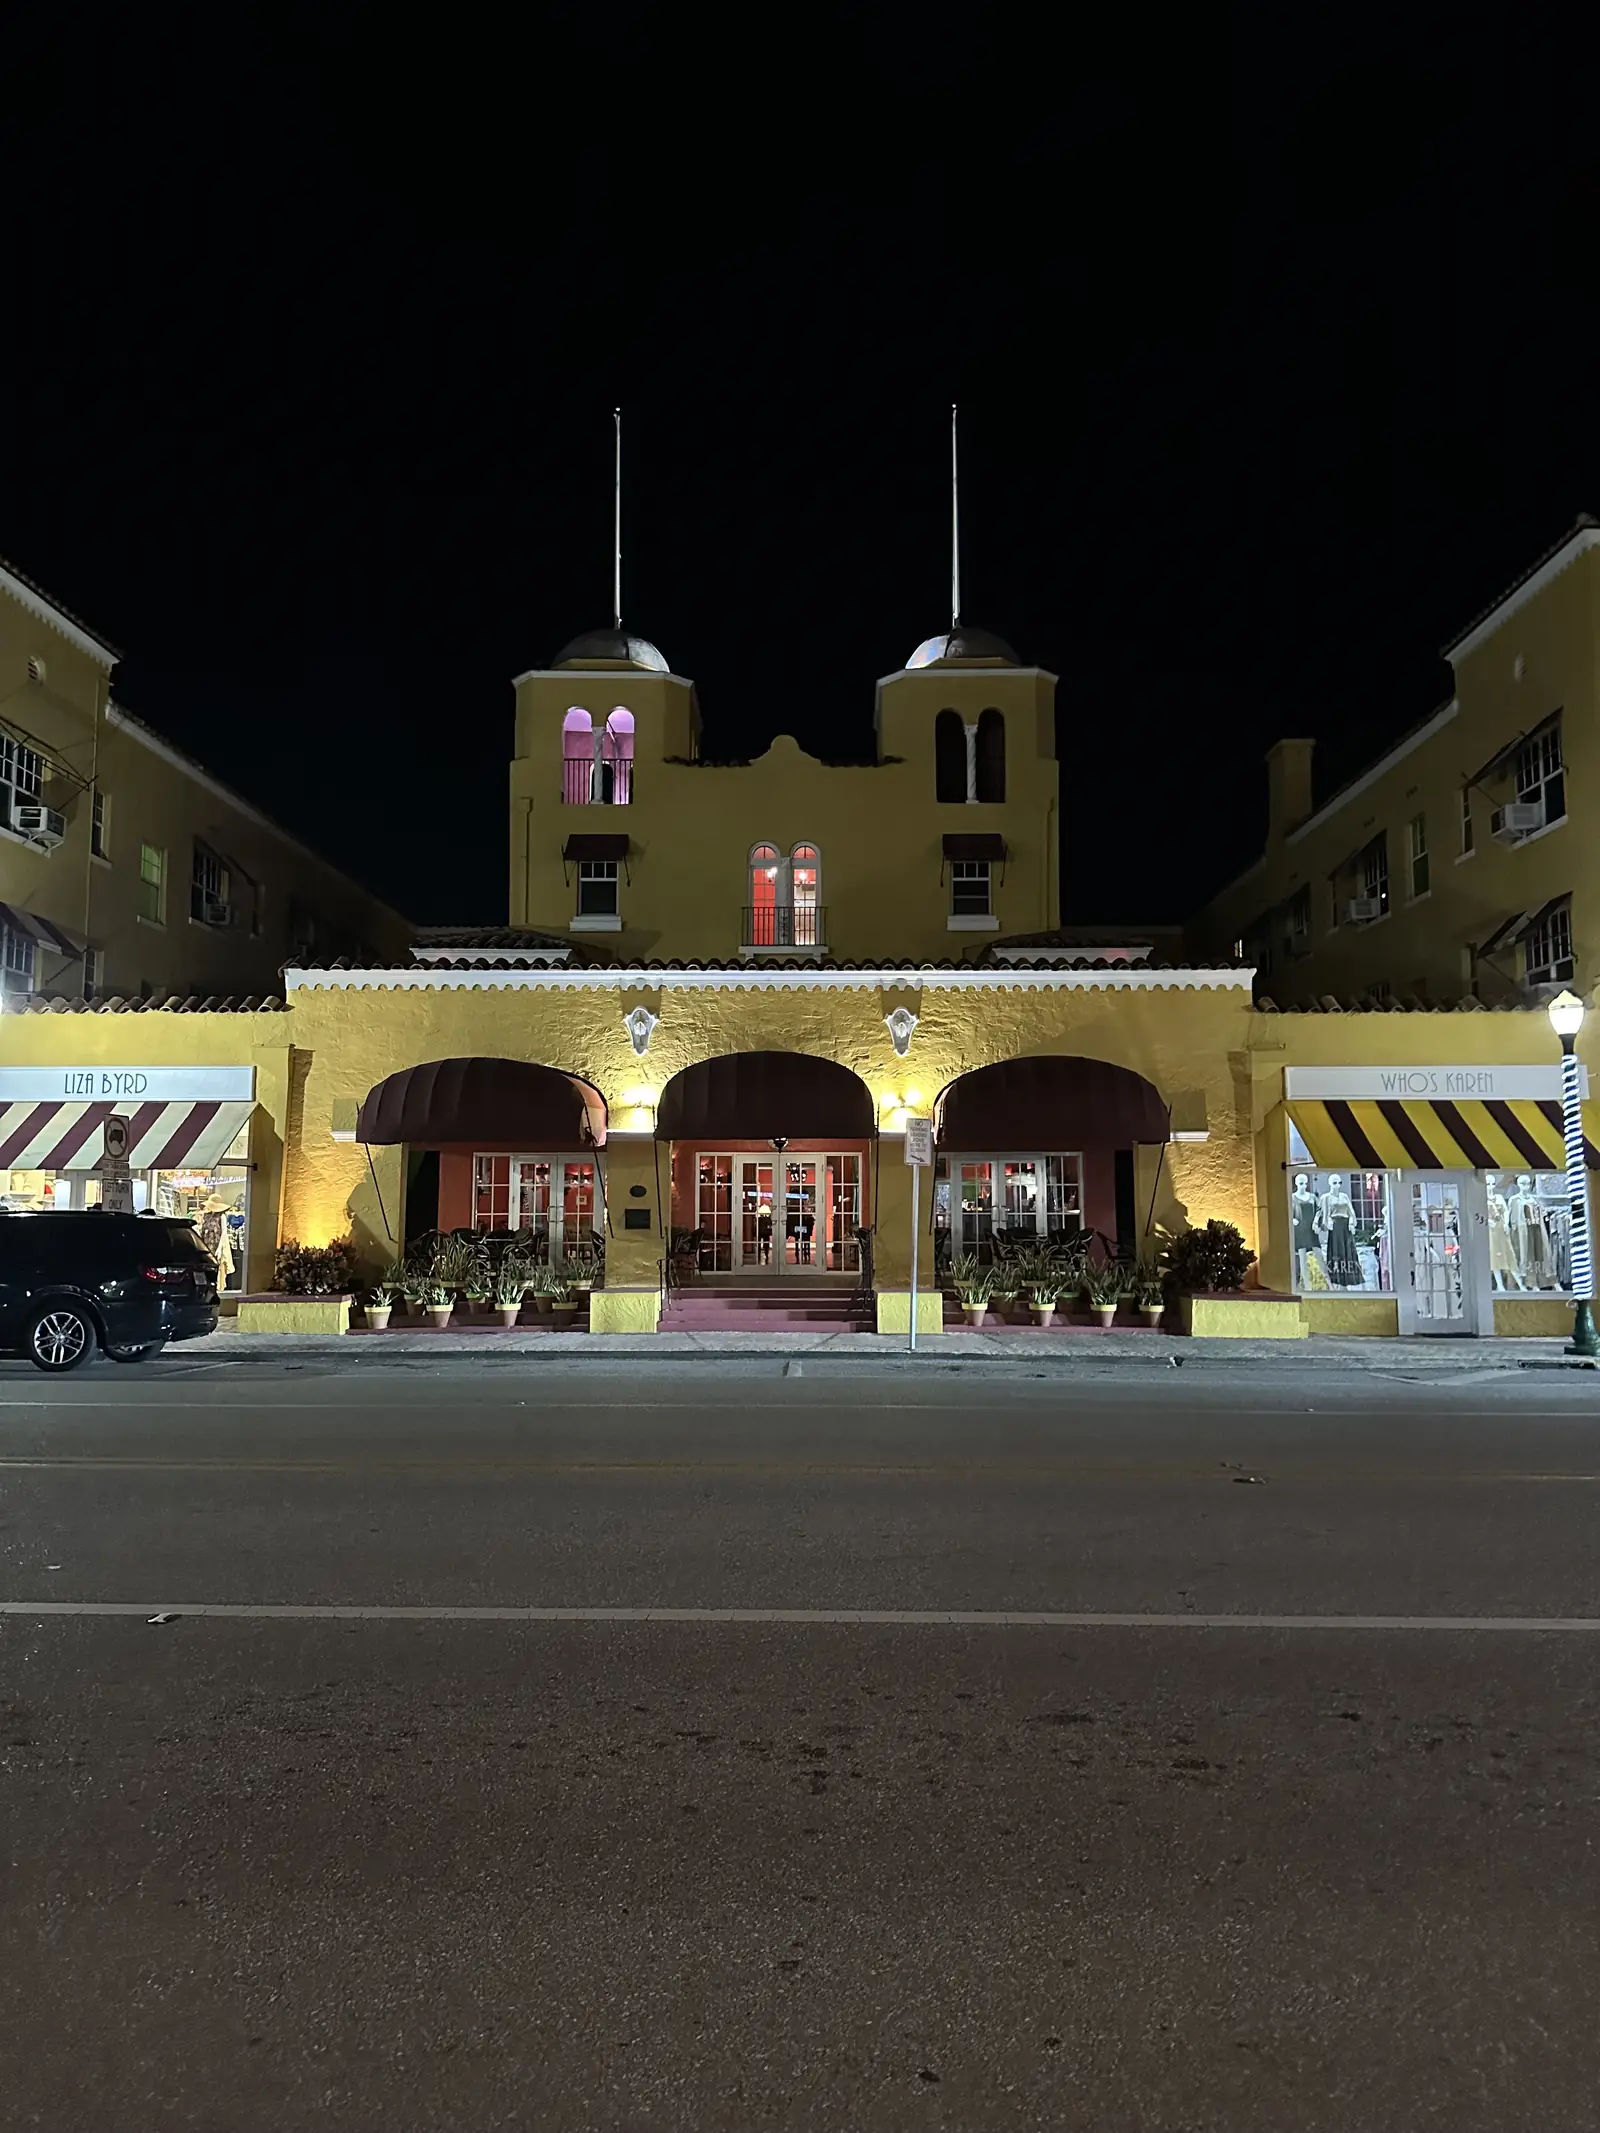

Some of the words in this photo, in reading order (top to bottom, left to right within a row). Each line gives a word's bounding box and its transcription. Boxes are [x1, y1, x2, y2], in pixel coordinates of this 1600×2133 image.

[64, 1073, 94, 1094] LIZA
[102, 1073, 148, 1094] BYRD
[1380, 1072, 1438, 1093] WHO'S
[1446, 1072, 1494, 1093] KAREN
[104, 1181, 114, 1193] LEFT
[109, 1199, 123, 1210] ONLY
